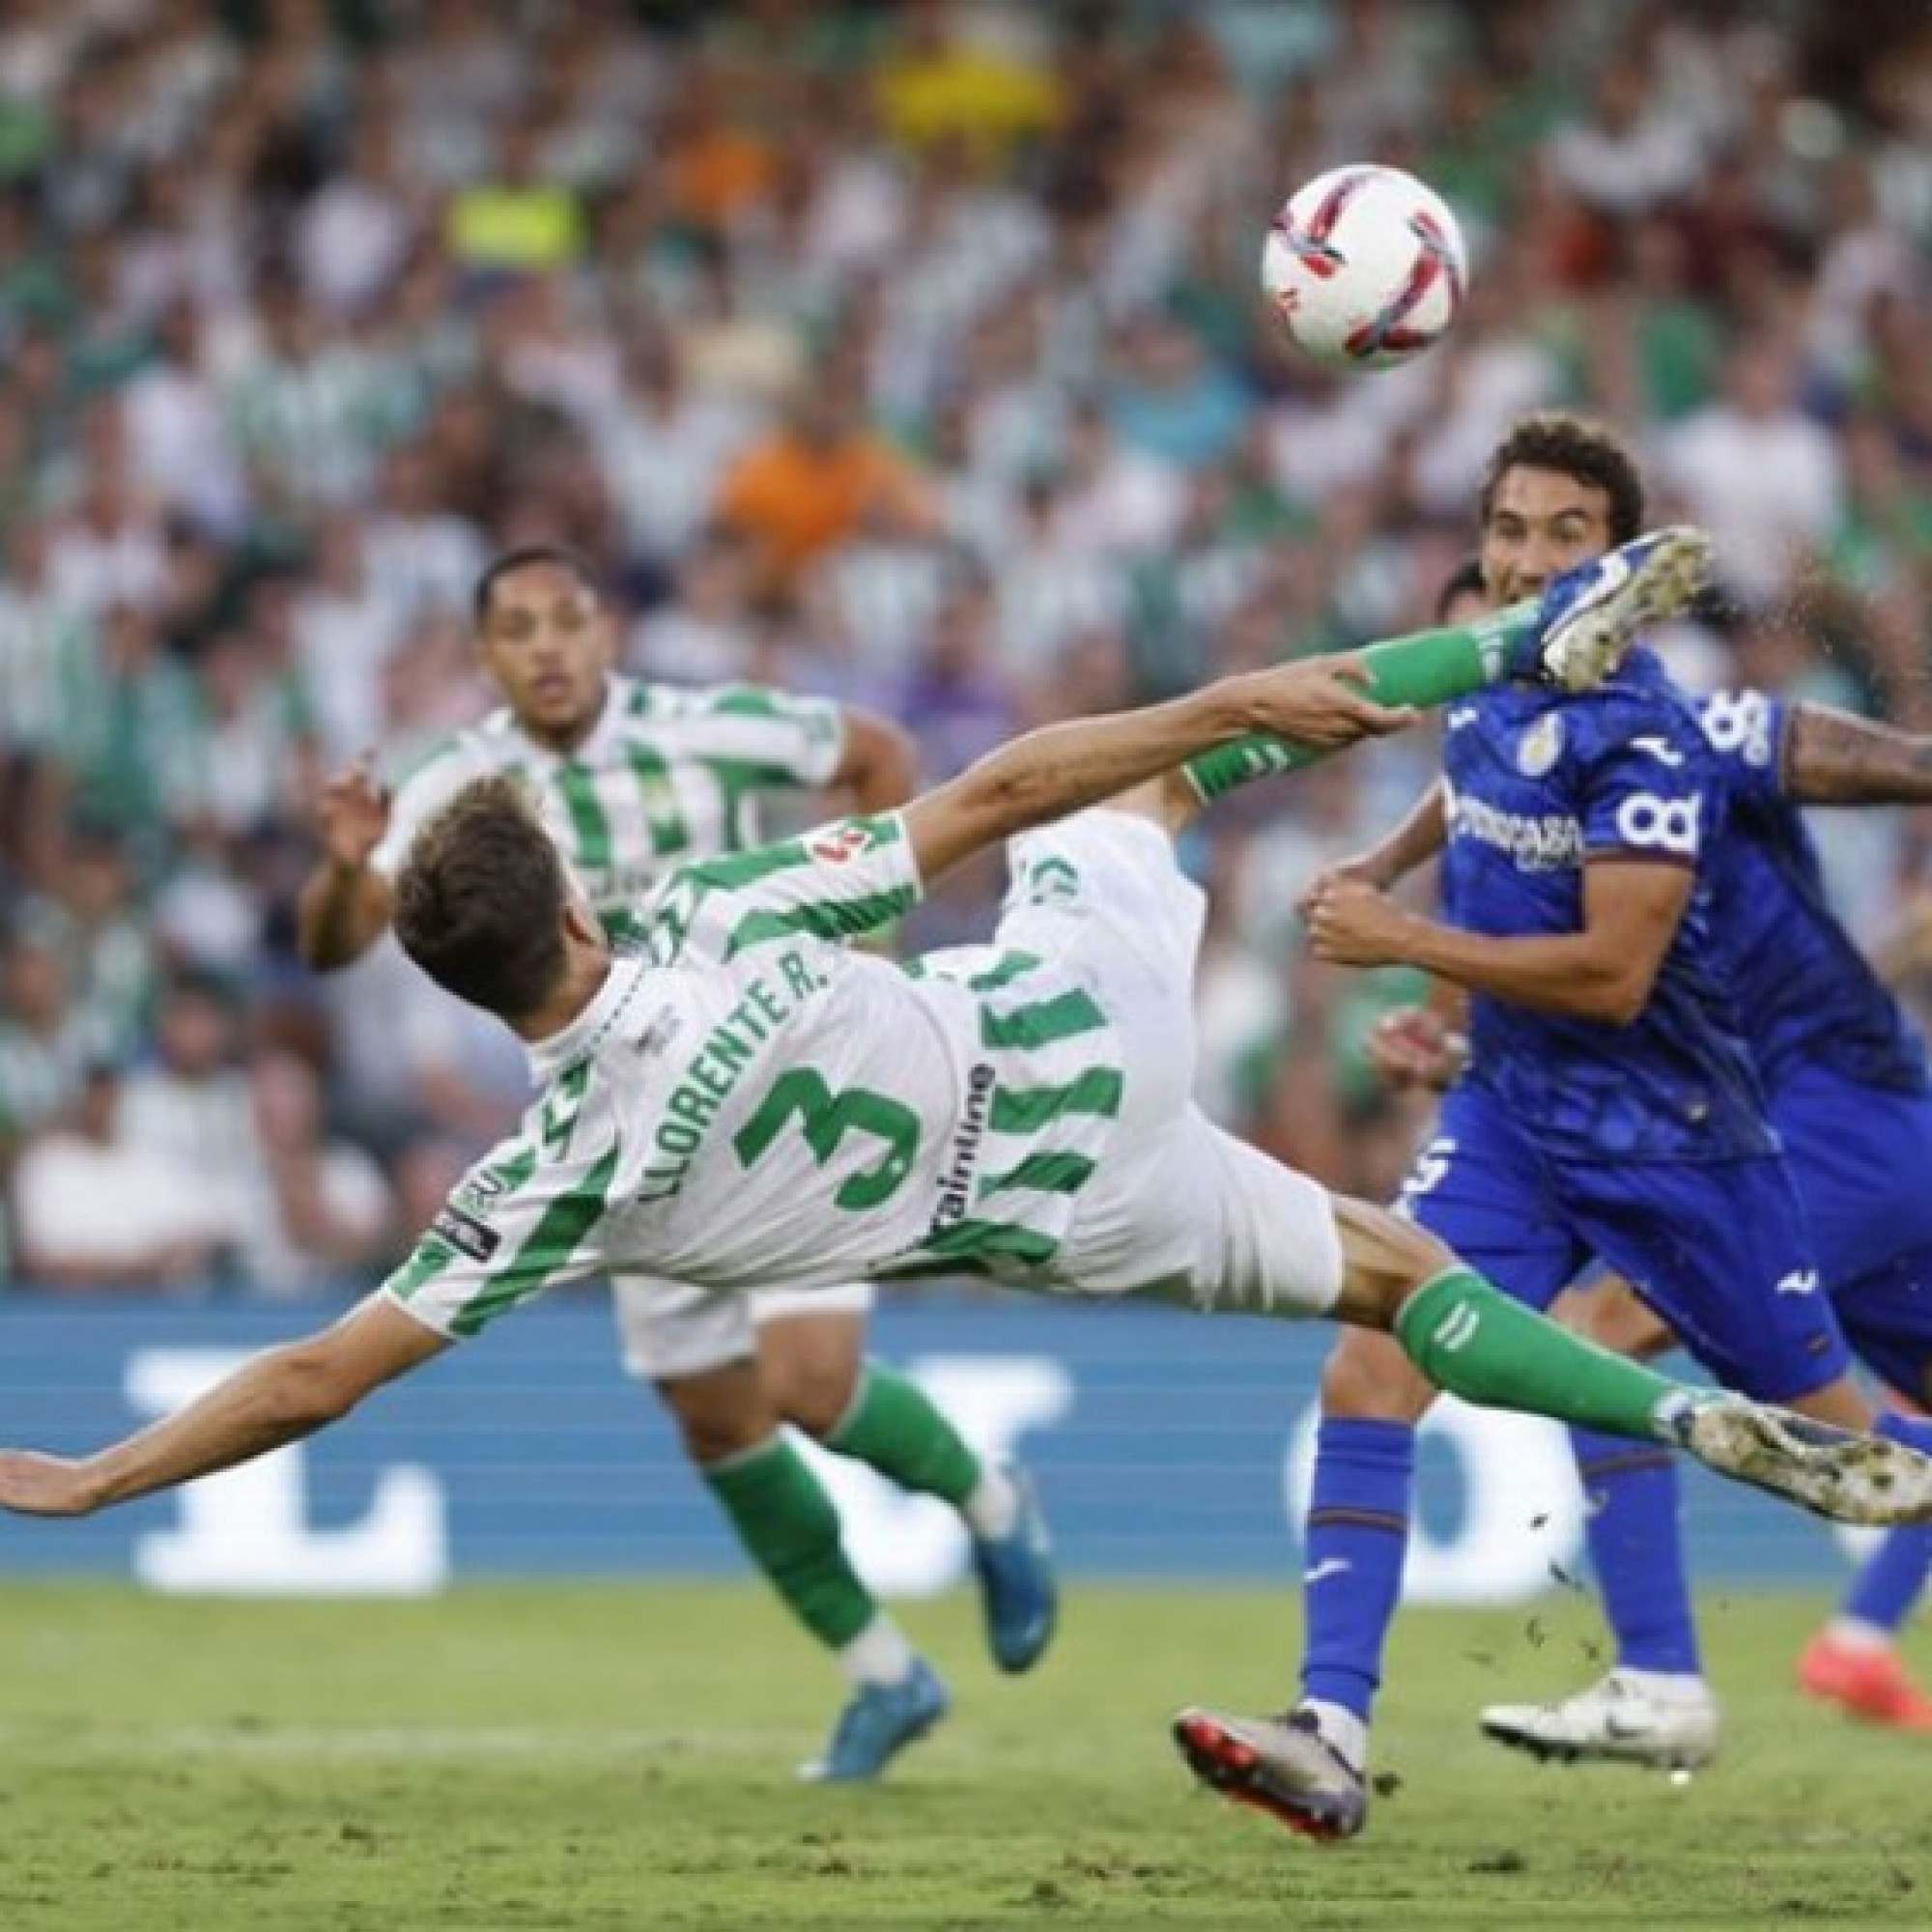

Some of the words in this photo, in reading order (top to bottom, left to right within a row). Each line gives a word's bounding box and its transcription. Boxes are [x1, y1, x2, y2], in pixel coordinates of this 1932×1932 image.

[637, 976, 791, 1204] LLORENTE
[778, 949, 830, 1001] R.
[733, 1066, 923, 1212] 3
